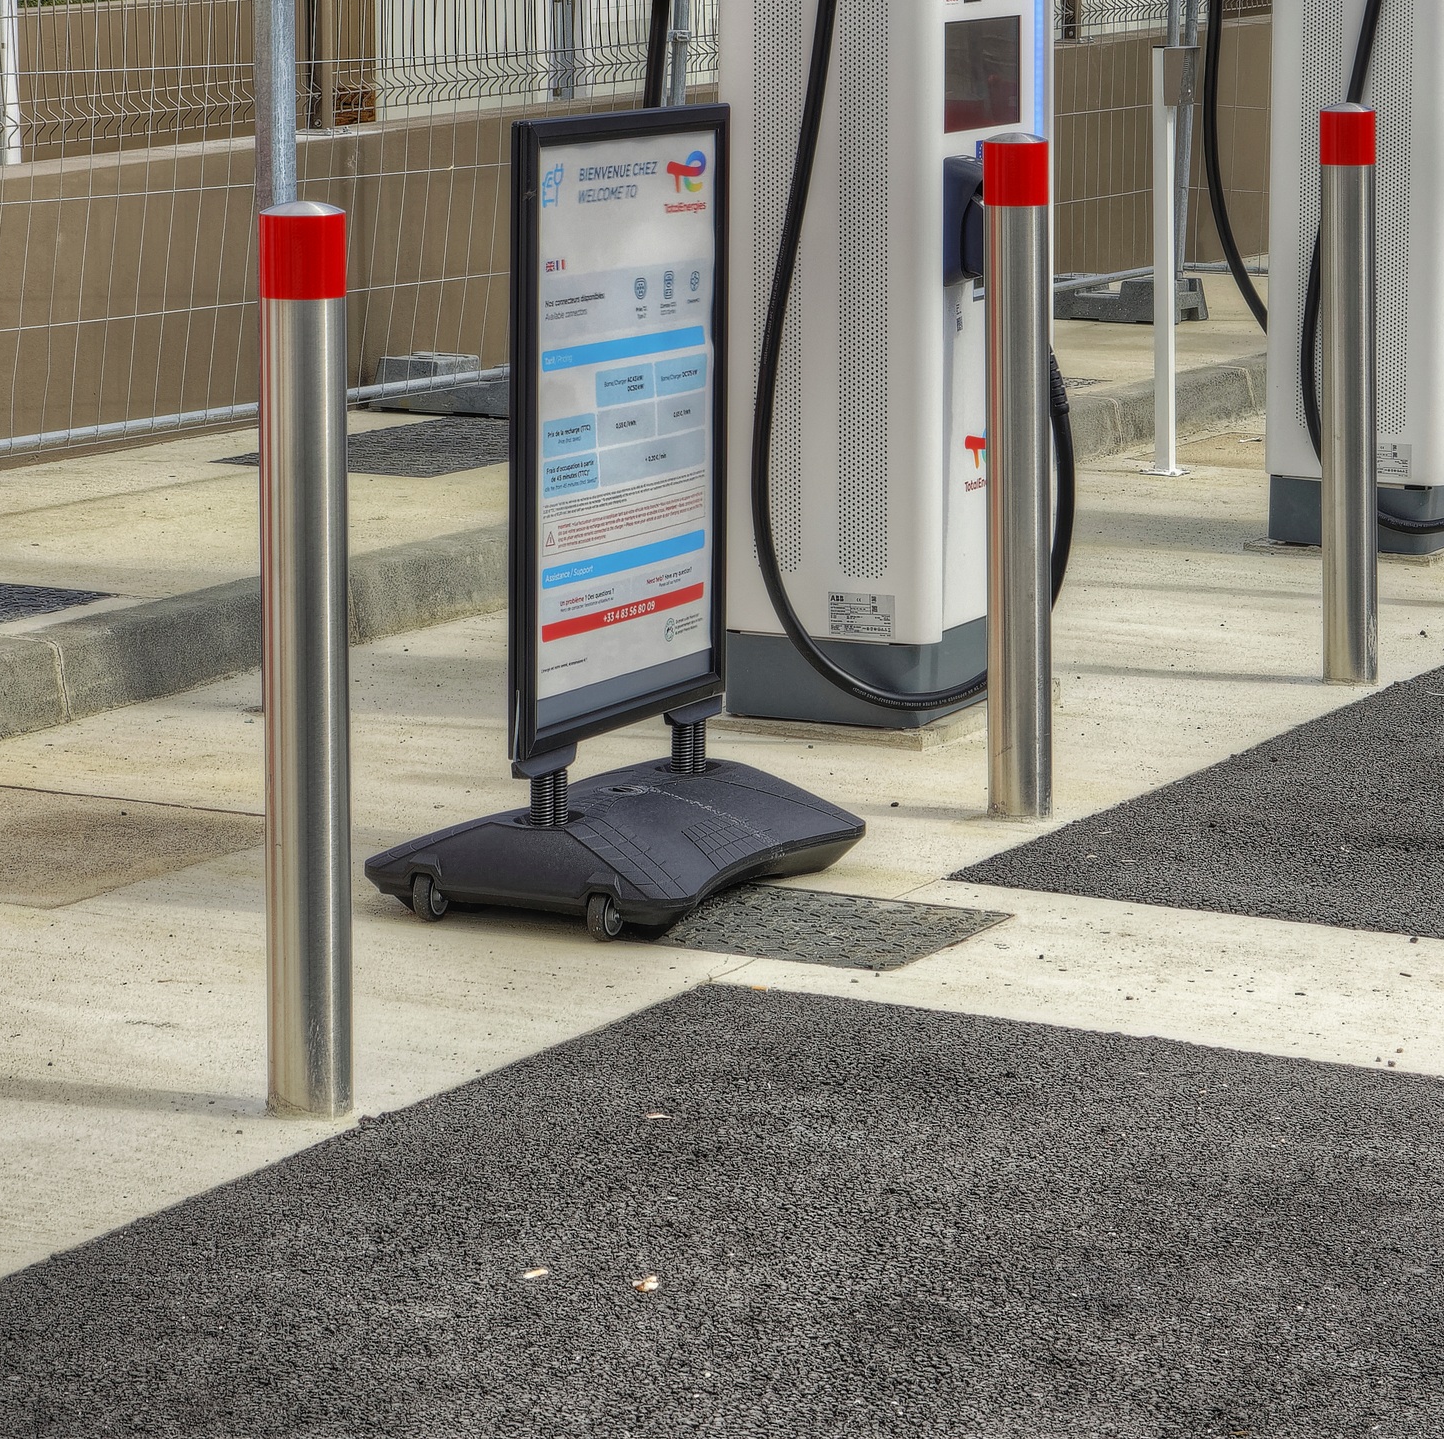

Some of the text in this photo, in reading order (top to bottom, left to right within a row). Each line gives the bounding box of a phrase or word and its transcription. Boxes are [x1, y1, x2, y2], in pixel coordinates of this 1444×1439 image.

[578, 161, 658, 181] BIENVENUE CHEZ
[578, 184, 637, 203] WELCOME TO
[964, 477, 987, 492] TotalEn
[545, 565, 593, 583] Assistance Support
[603, 611, 614, 622] +33
[616, 610, 619, 619] 4
[621, 608, 628, 619] 83
